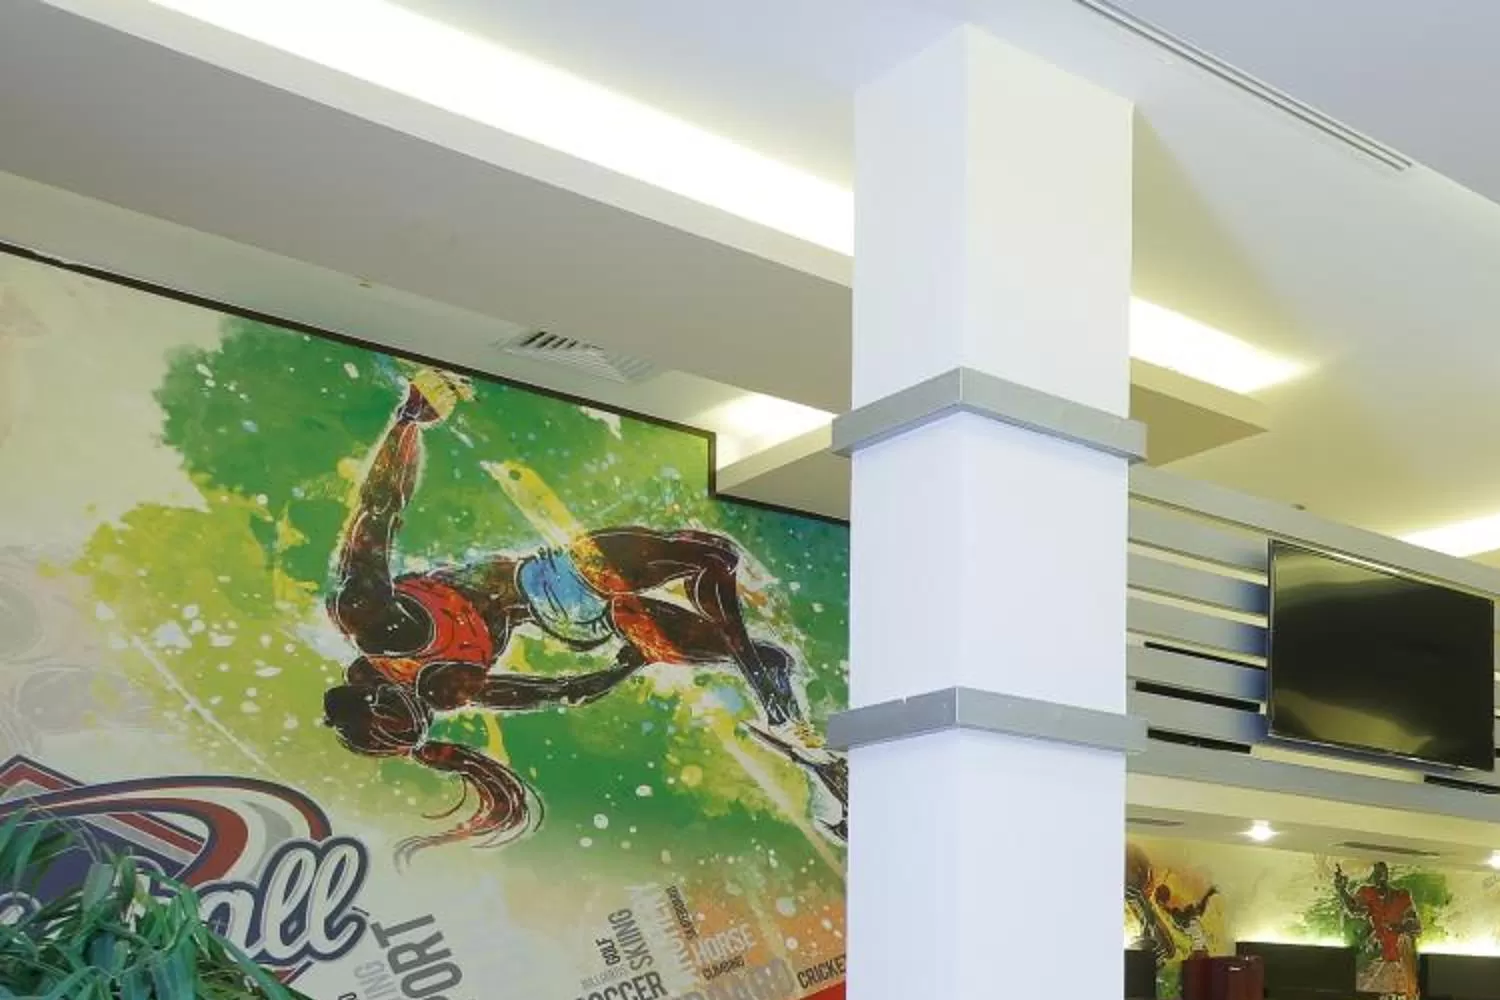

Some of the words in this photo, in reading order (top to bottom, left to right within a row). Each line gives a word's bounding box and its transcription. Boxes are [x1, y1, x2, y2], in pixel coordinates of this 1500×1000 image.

[594, 937, 621, 967] GOLF
[607, 907, 655, 971] SKIING
[796, 953, 846, 990] CRICKE
